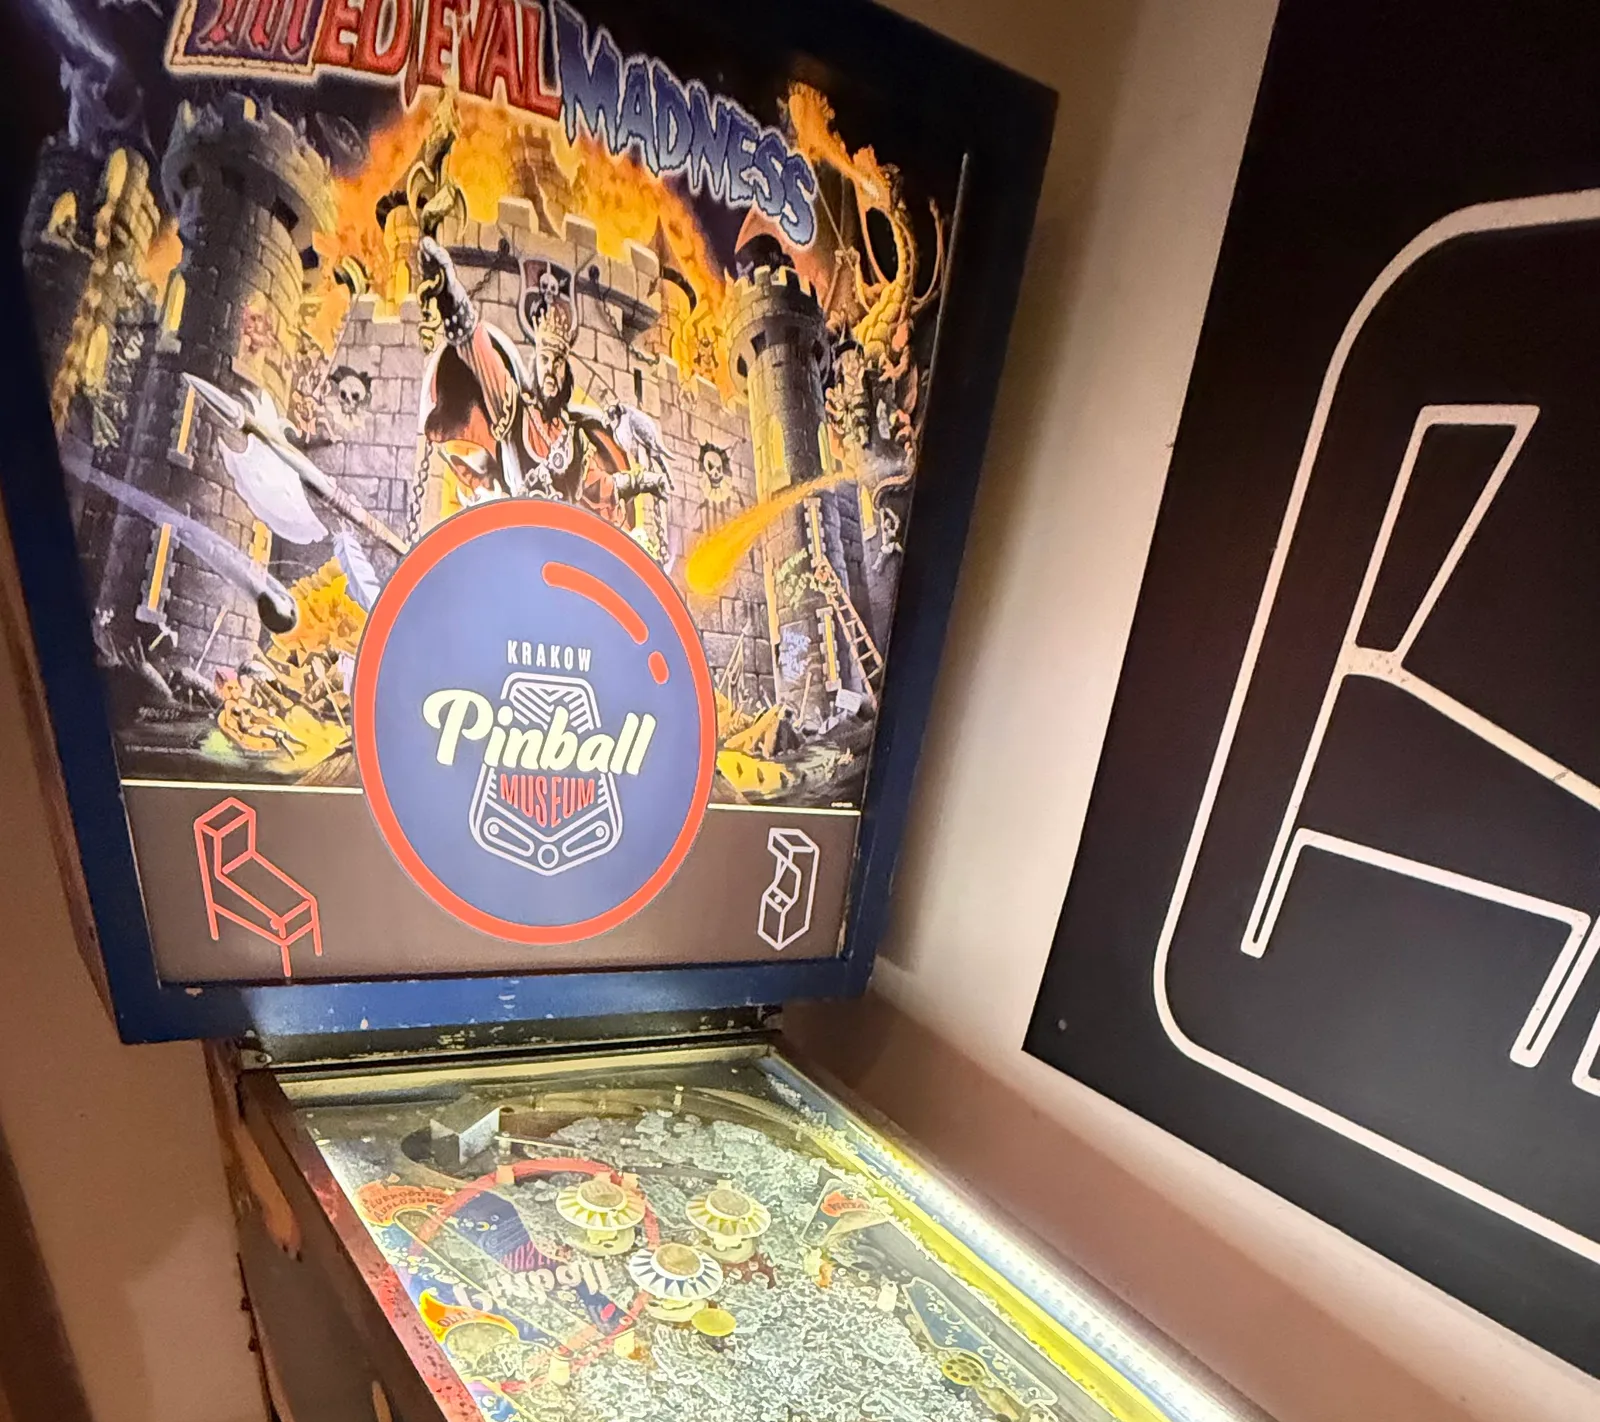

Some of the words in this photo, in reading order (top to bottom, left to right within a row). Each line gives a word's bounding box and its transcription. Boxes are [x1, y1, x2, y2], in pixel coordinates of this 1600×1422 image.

[556, 6, 815, 246] MADNESS
[507, 639, 592, 672] KRAKOW
[422, 688, 657, 776] Pinball
[500, 773, 595, 828] MUSEUM
